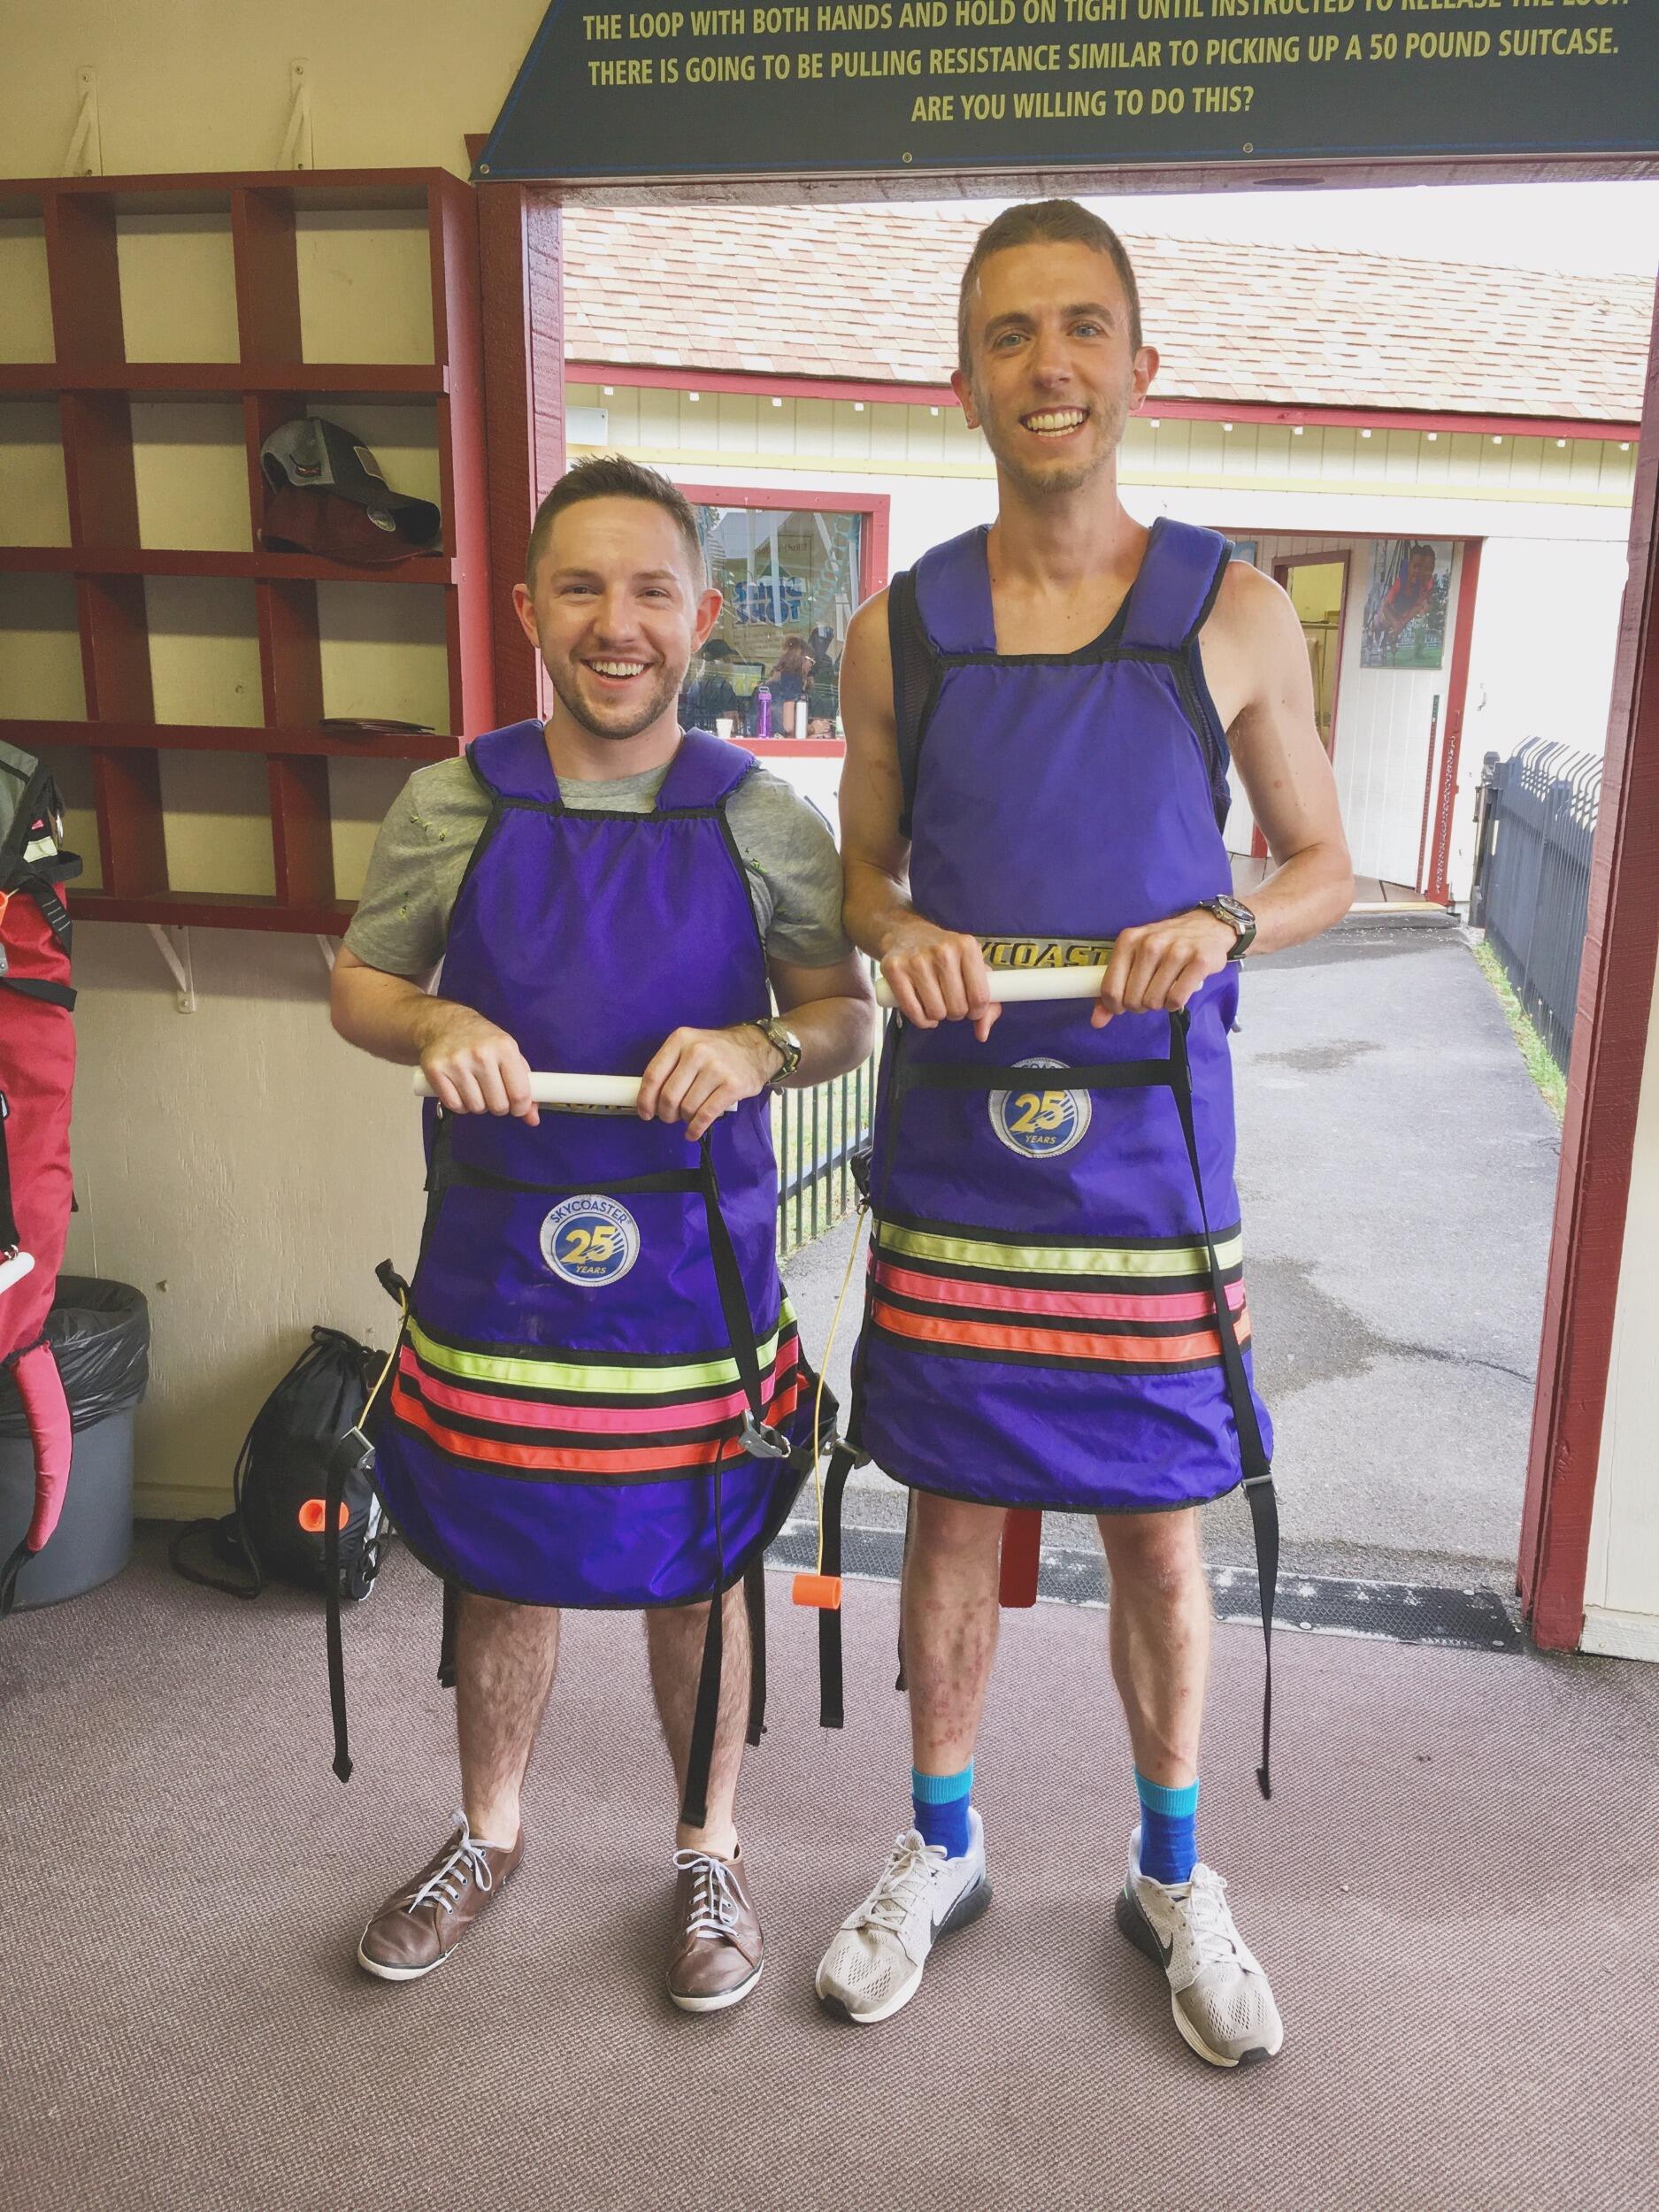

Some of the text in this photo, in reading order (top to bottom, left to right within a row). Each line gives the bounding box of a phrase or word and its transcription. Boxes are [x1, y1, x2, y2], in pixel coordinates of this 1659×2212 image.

[584, 15, 622, 40] THE
[629, 12, 683, 38] LOOP
[690, 11, 745, 35] WITH
[752, 7, 809, 34] BOTH
[817, 4, 892, 30] HANDS
[899, 0, 948, 27] AND
[955, 0, 1015, 26] HOLD
[1022, 0, 1056, 23] ON
[1065, 0, 1126, 21] TIGHT
[1138, 0, 1202, 19] UNTIL
[588, 28, 1617, 84] THERE IS GOING TO BE PULLING RESISTANCE SIMILAR TO PICKING UP A 50 POUND SUITCASE.
[910, 86, 1254, 121] ARE YOU WILLING TO DO THIS?
[1009, 1090, 1066, 1133] 25
[1025, 1135, 1056, 1144] YEARS
[550, 1200, 626, 1223] SKYCOASTER
[559, 1225, 618, 1263] 25
